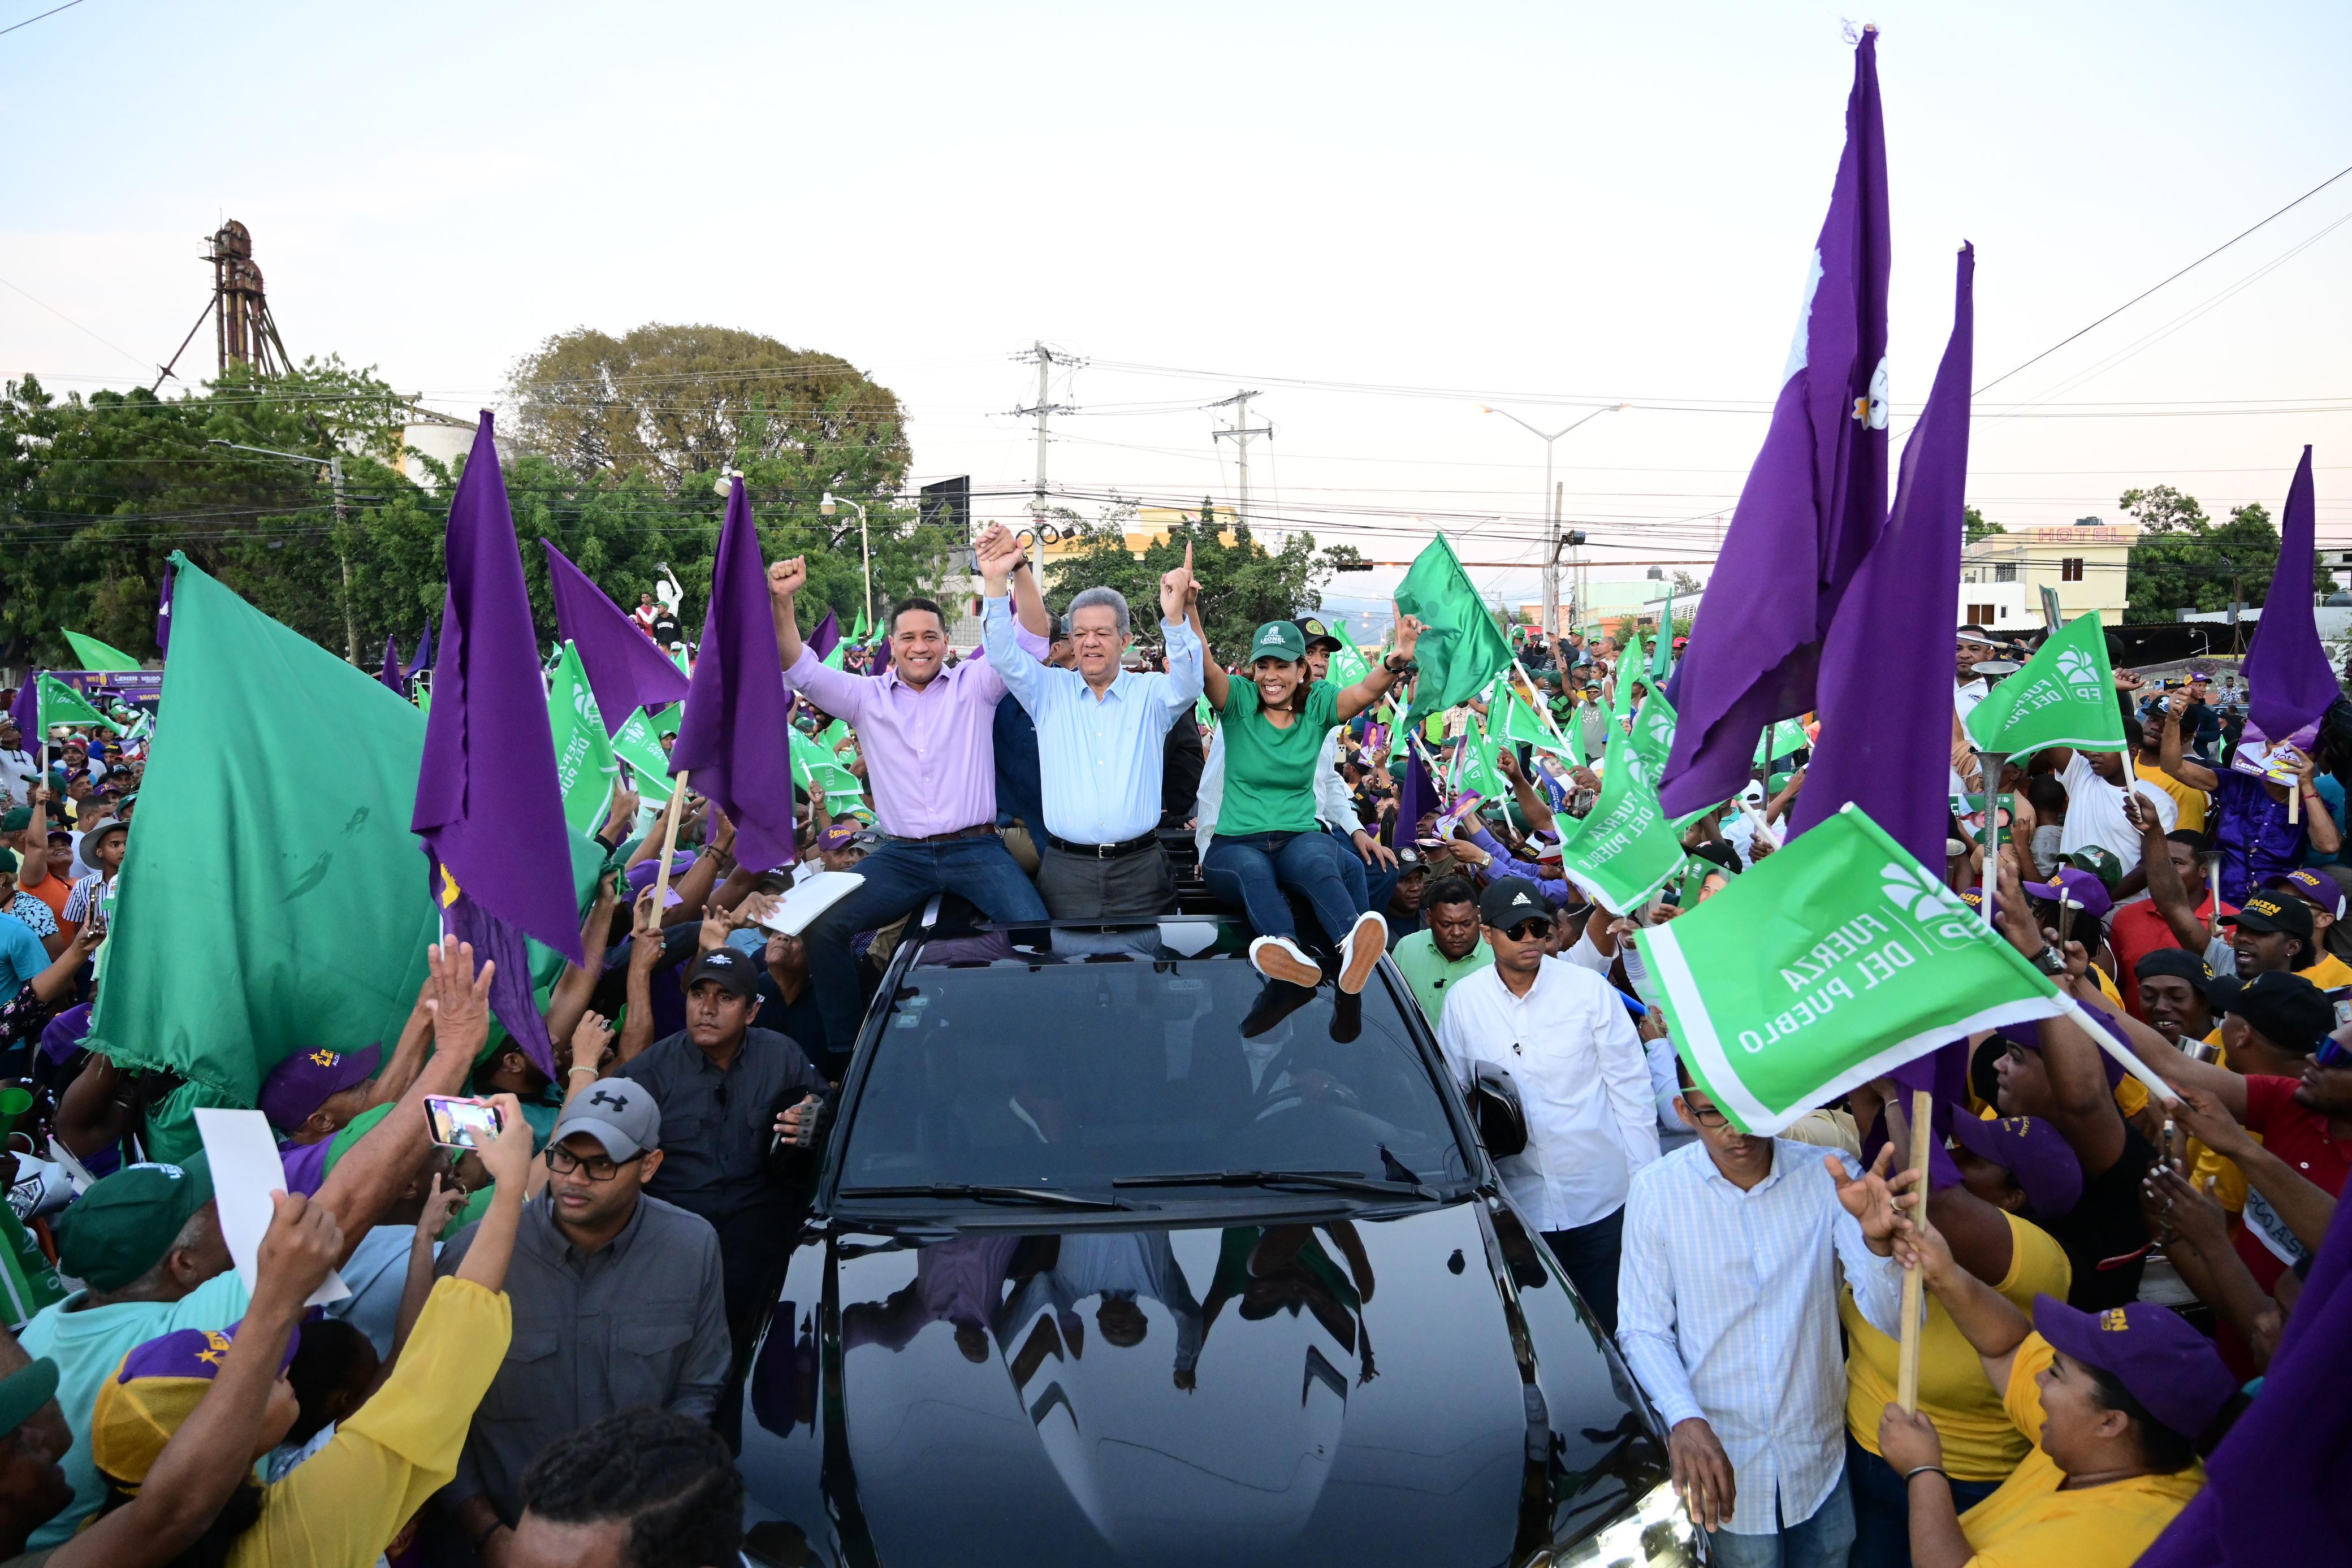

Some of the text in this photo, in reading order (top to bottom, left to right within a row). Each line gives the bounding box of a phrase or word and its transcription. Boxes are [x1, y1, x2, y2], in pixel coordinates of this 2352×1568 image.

[2039, 528, 2126, 542] HOTEL
[647, 747, 664, 761] DEL
[2235, 762, 2265, 774] LENIN
[2267, 759, 2289, 781] 2
[1442, 825, 1450, 841] 2
